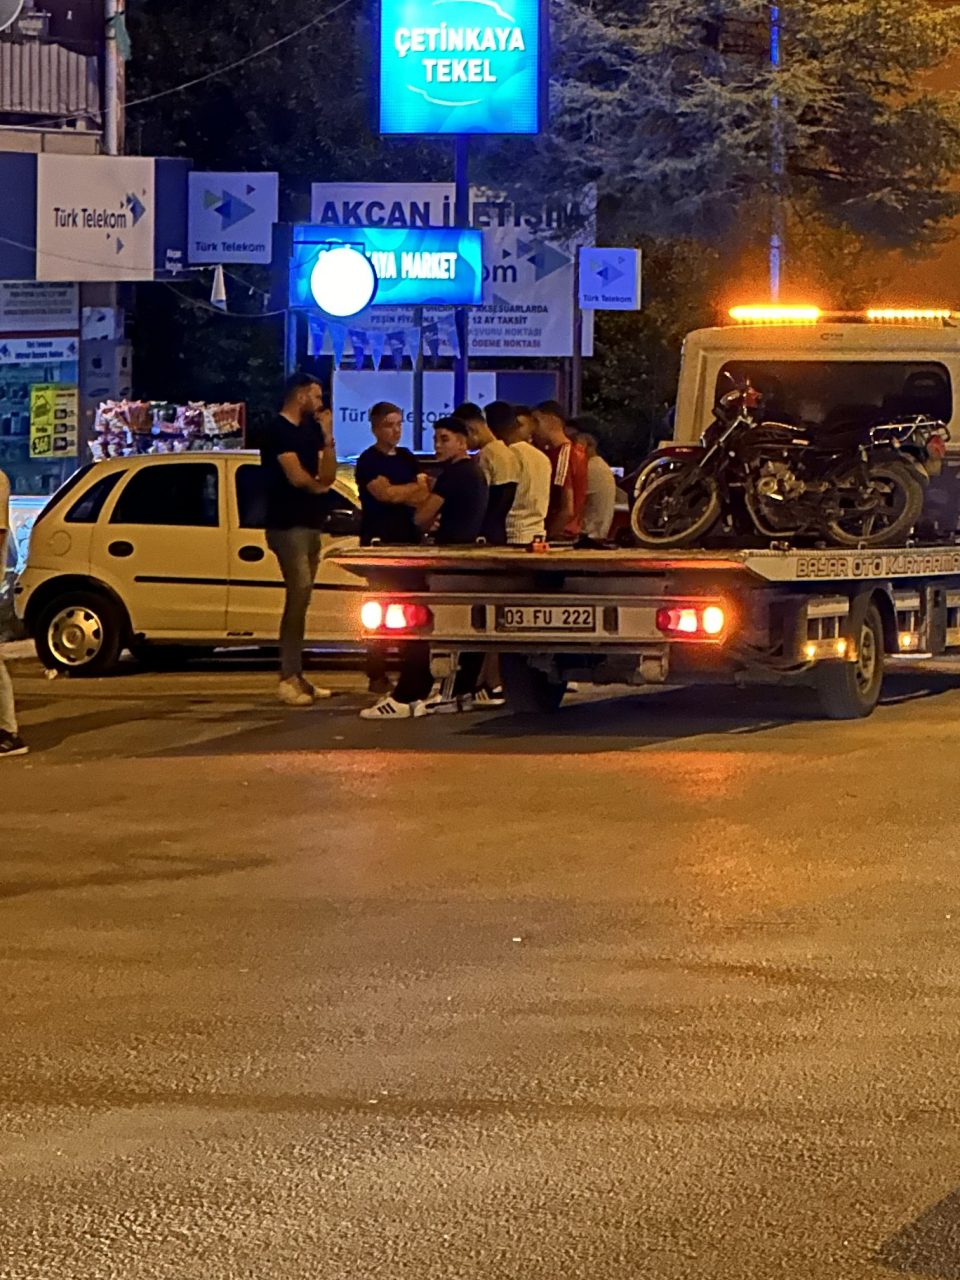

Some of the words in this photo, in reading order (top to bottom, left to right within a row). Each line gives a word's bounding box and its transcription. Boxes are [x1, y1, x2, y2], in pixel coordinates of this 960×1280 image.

[394, 21, 526, 58] ÇETİNKAYA
[421, 58, 498, 83] TEKEL
[53, 207, 79, 228] Türk
[81, 208, 127, 229] Telekom
[195, 241, 218, 252] Türk
[221, 241, 266, 253] Telekom
[401, 251, 458, 280] MARKET
[796, 558, 849, 578] BAYAR
[852, 557, 883, 577] OTO
[505, 609, 524, 625] 03
[533, 609, 553, 625] FU
[562, 609, 591, 625] 222
